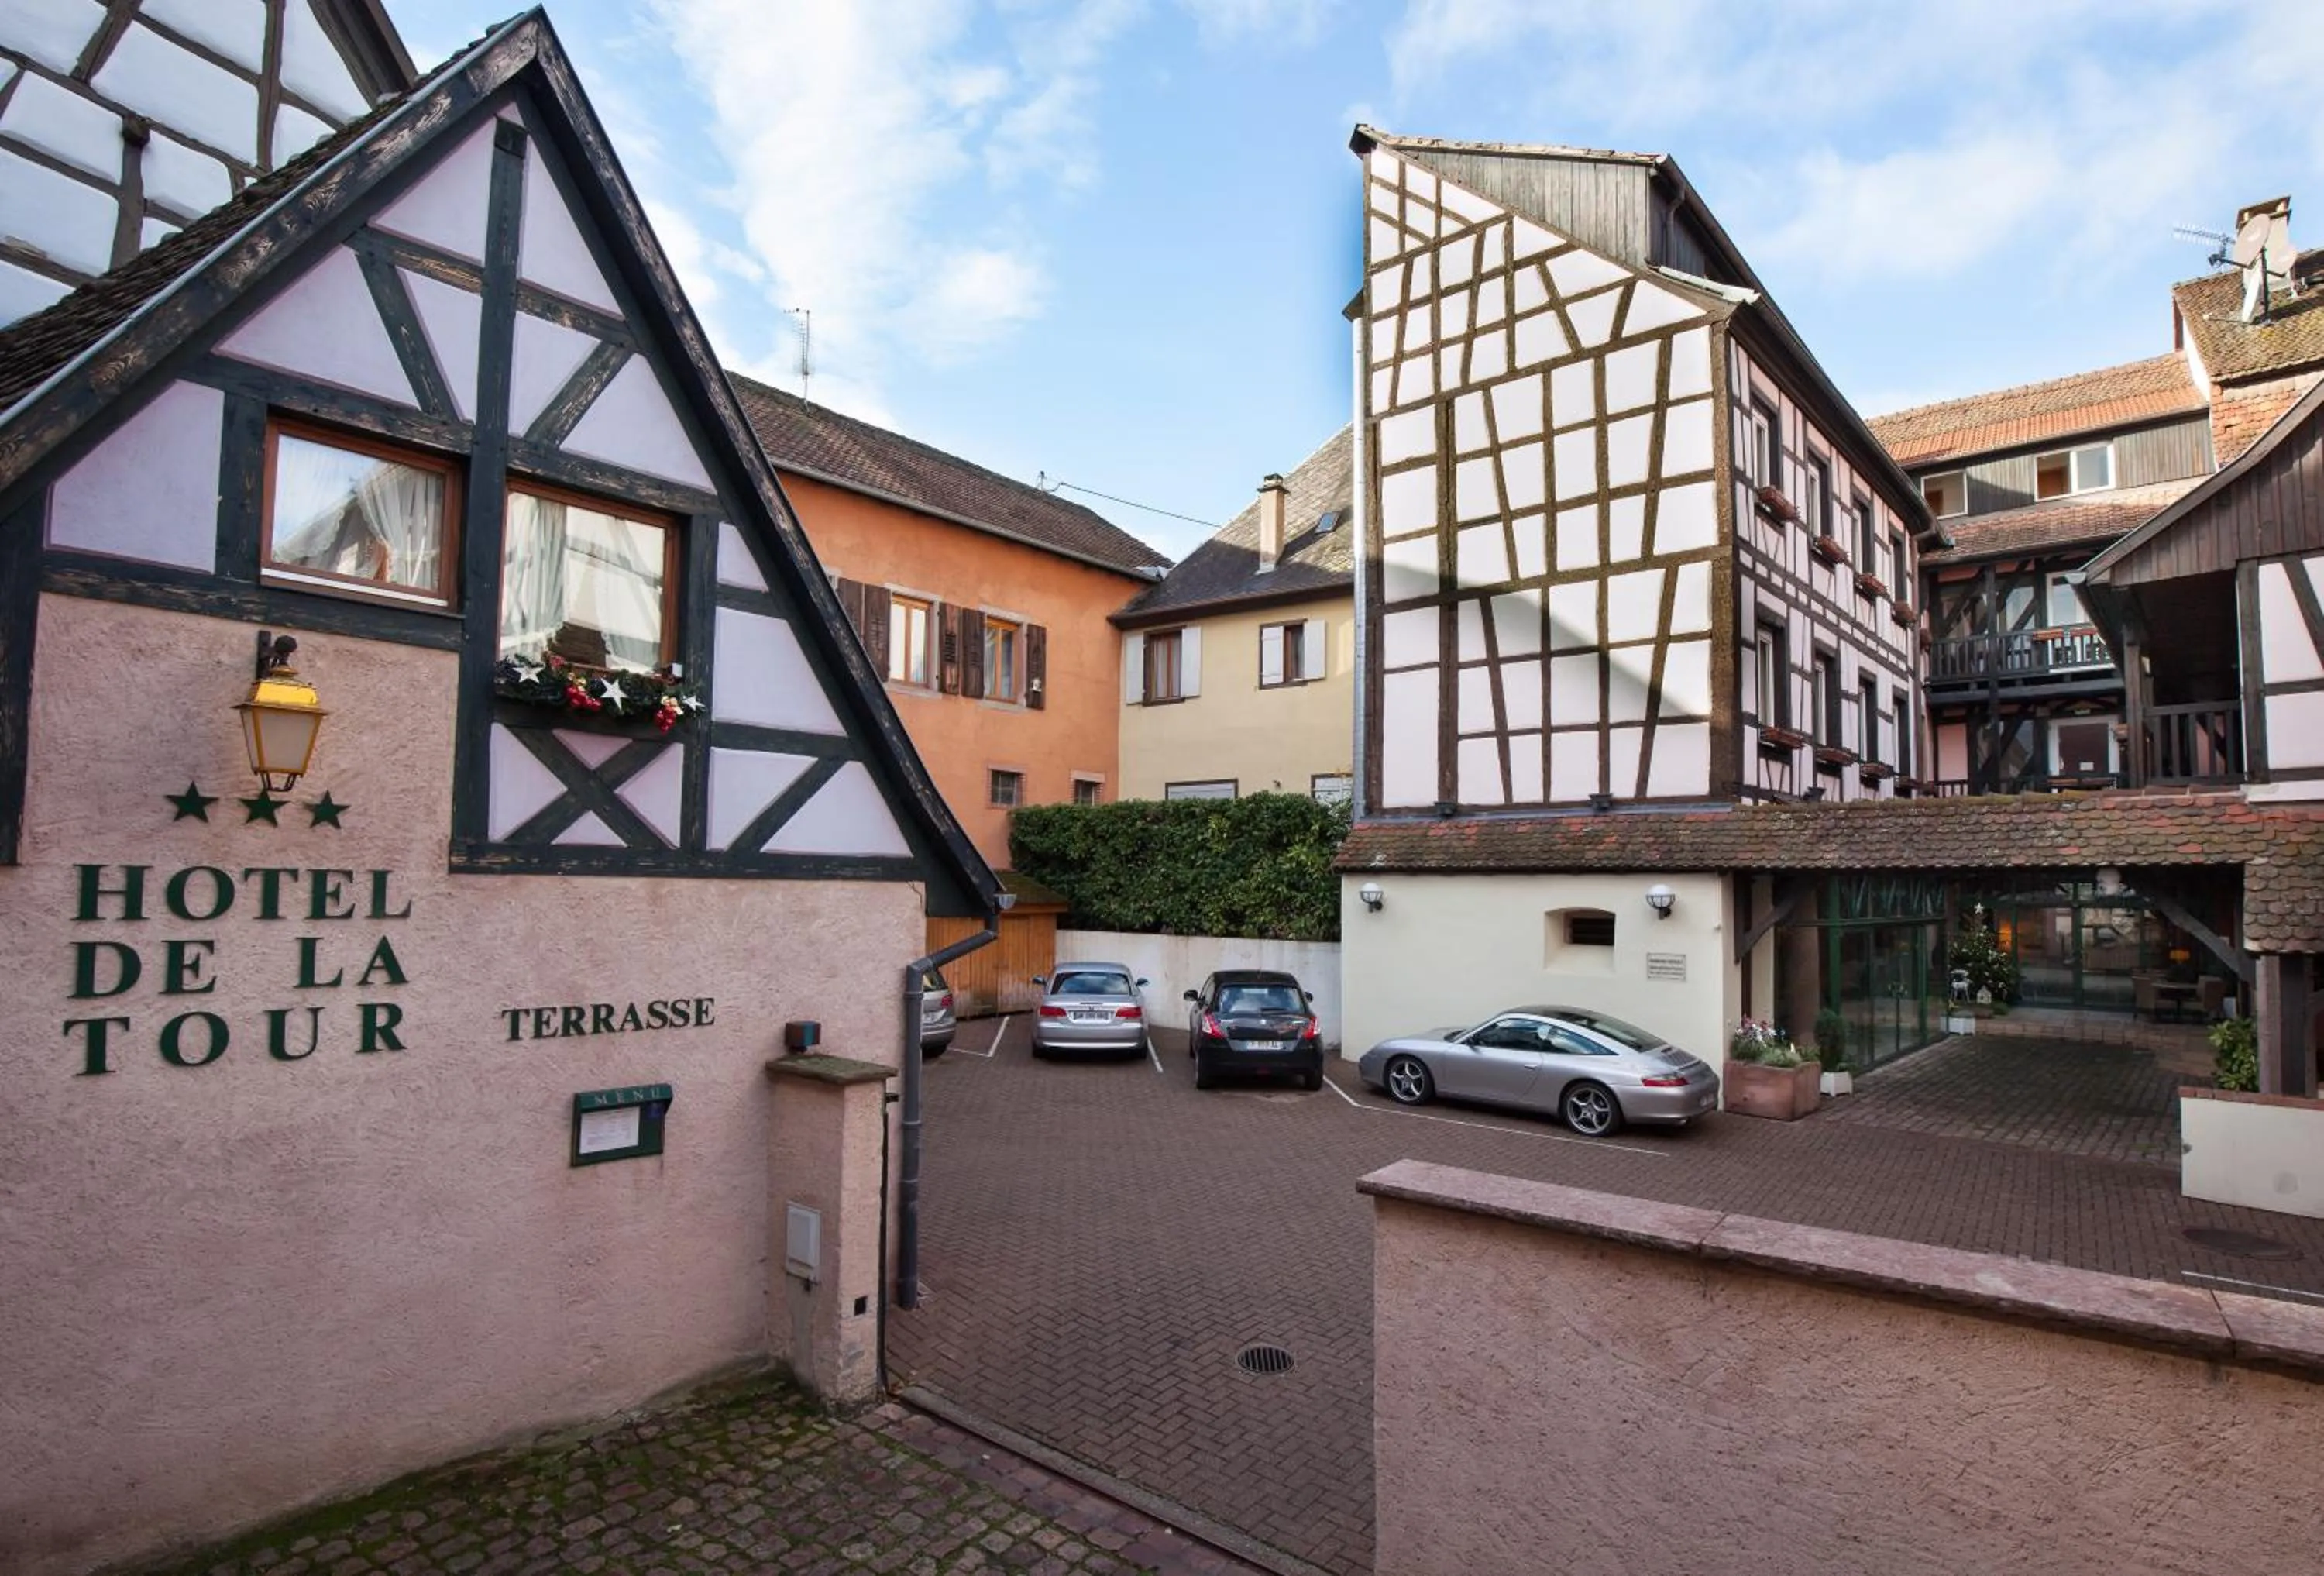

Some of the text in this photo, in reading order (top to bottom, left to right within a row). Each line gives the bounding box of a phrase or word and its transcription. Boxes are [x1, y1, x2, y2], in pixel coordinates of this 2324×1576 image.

[70, 864, 412, 921] HOTEL
[67, 934, 410, 999] DE LA
[63, 1002, 407, 1076] TOUR
[500, 997, 716, 1042] TERRASSE
[594, 1087, 659, 1104] MENU
